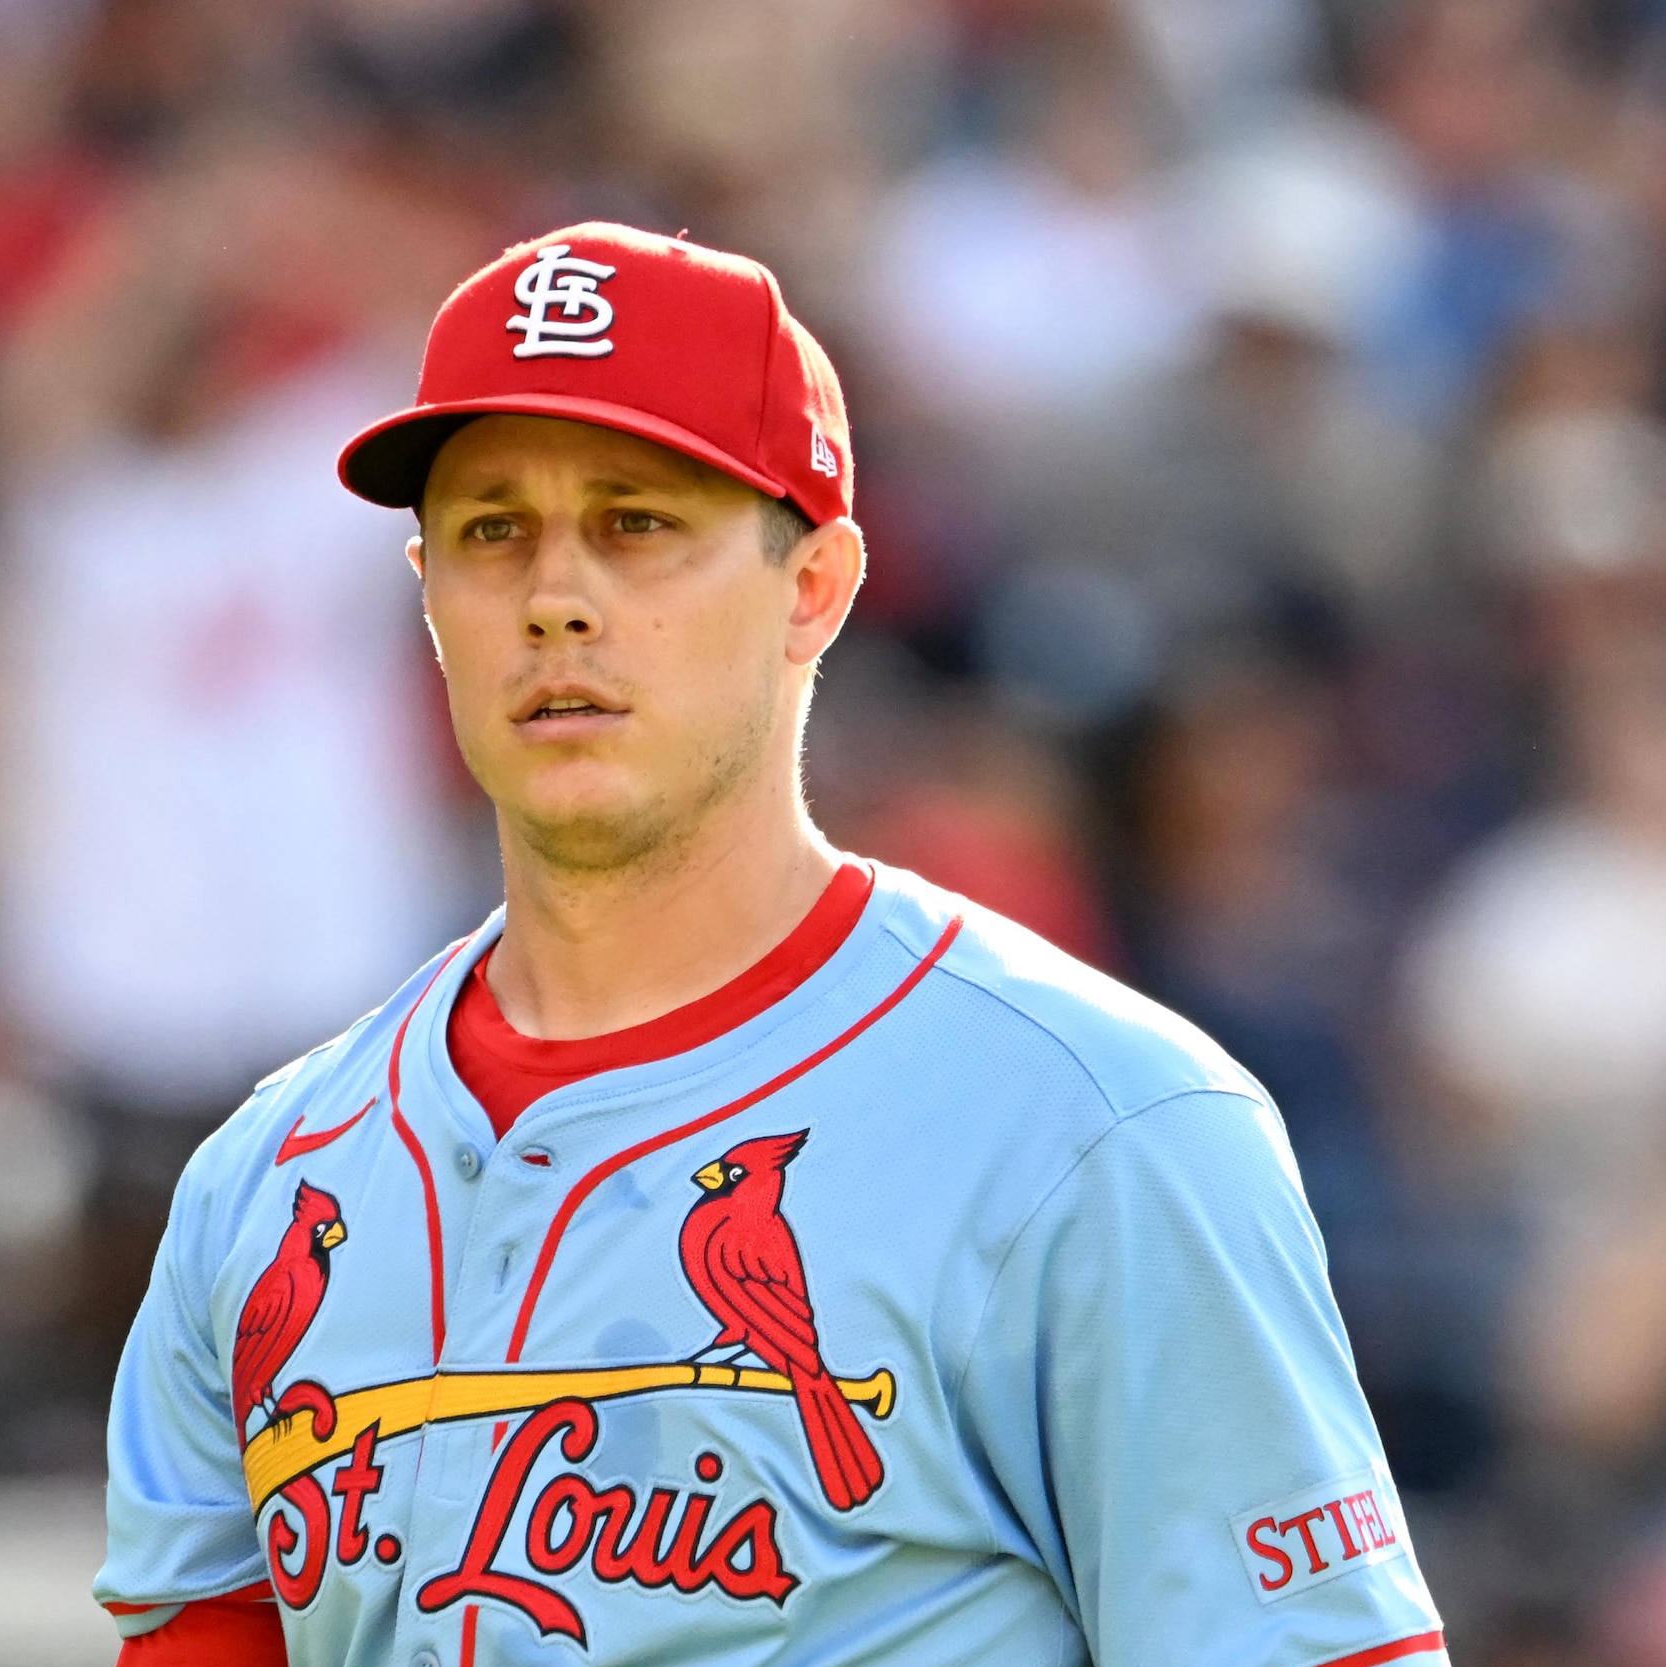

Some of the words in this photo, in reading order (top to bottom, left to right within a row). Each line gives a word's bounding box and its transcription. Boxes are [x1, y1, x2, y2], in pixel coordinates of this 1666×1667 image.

[268, 1379, 402, 1610] St.
[416, 1396, 801, 1651] Louis
[1245, 1489, 1397, 1592] STIFEL
